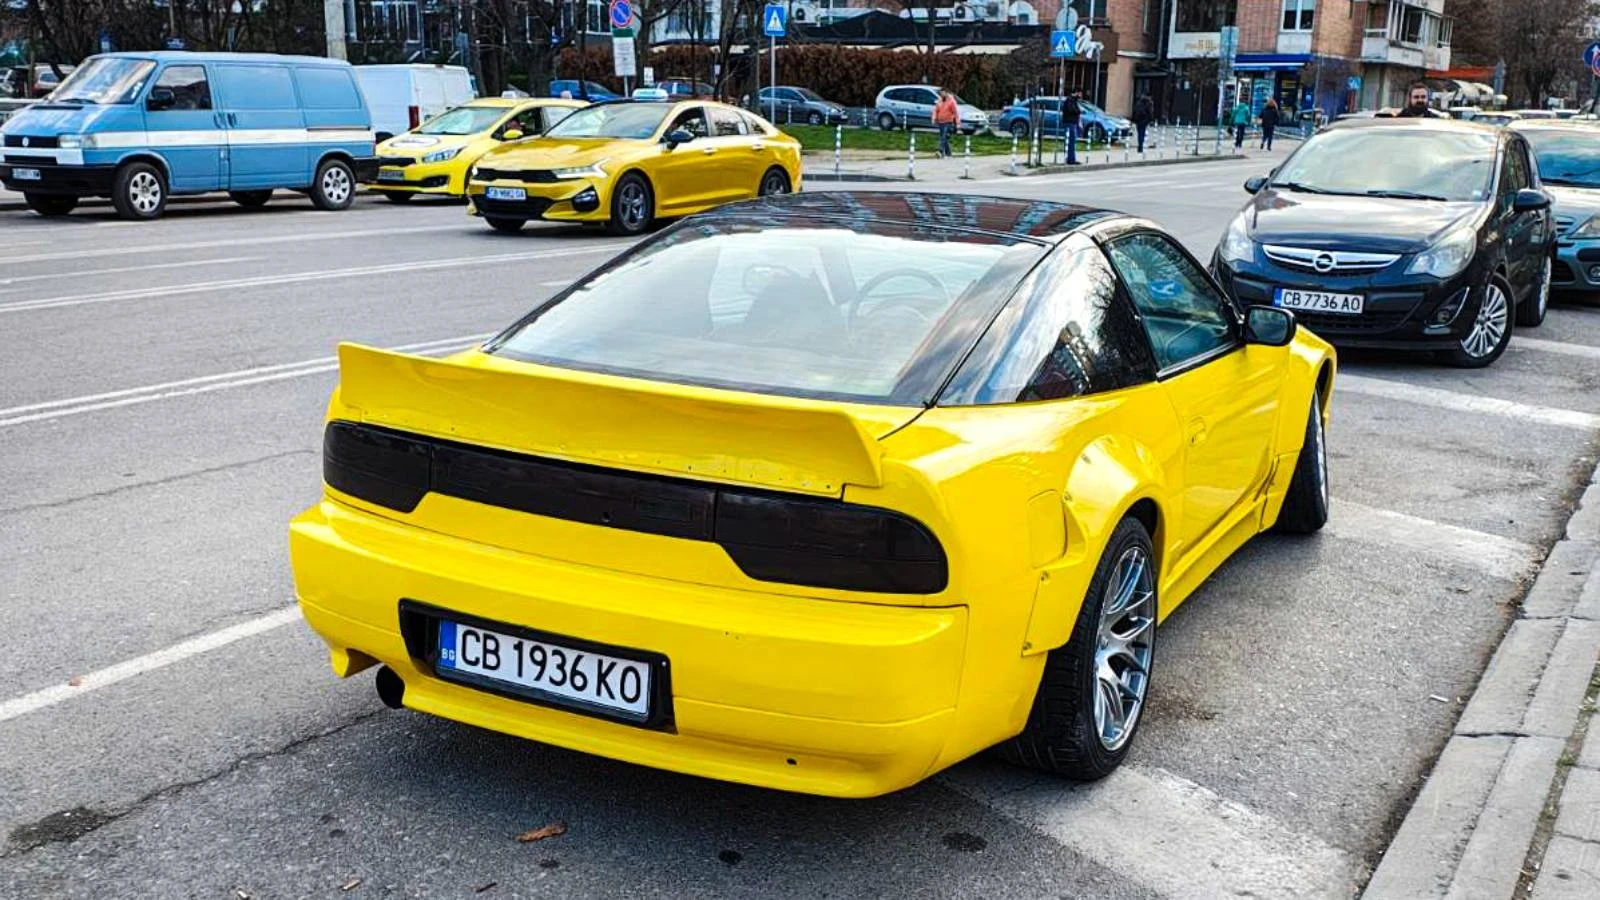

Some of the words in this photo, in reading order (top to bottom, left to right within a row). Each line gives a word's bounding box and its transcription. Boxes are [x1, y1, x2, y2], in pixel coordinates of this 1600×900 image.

[1283, 291, 1302, 306] CB
[1302, 293, 1338, 310] 7736
[1341, 296, 1361, 311] AO
[440, 647, 456, 662] BG
[461, 629, 501, 671] CB
[513, 640, 589, 693] 1936
[595, 658, 642, 704] KO
